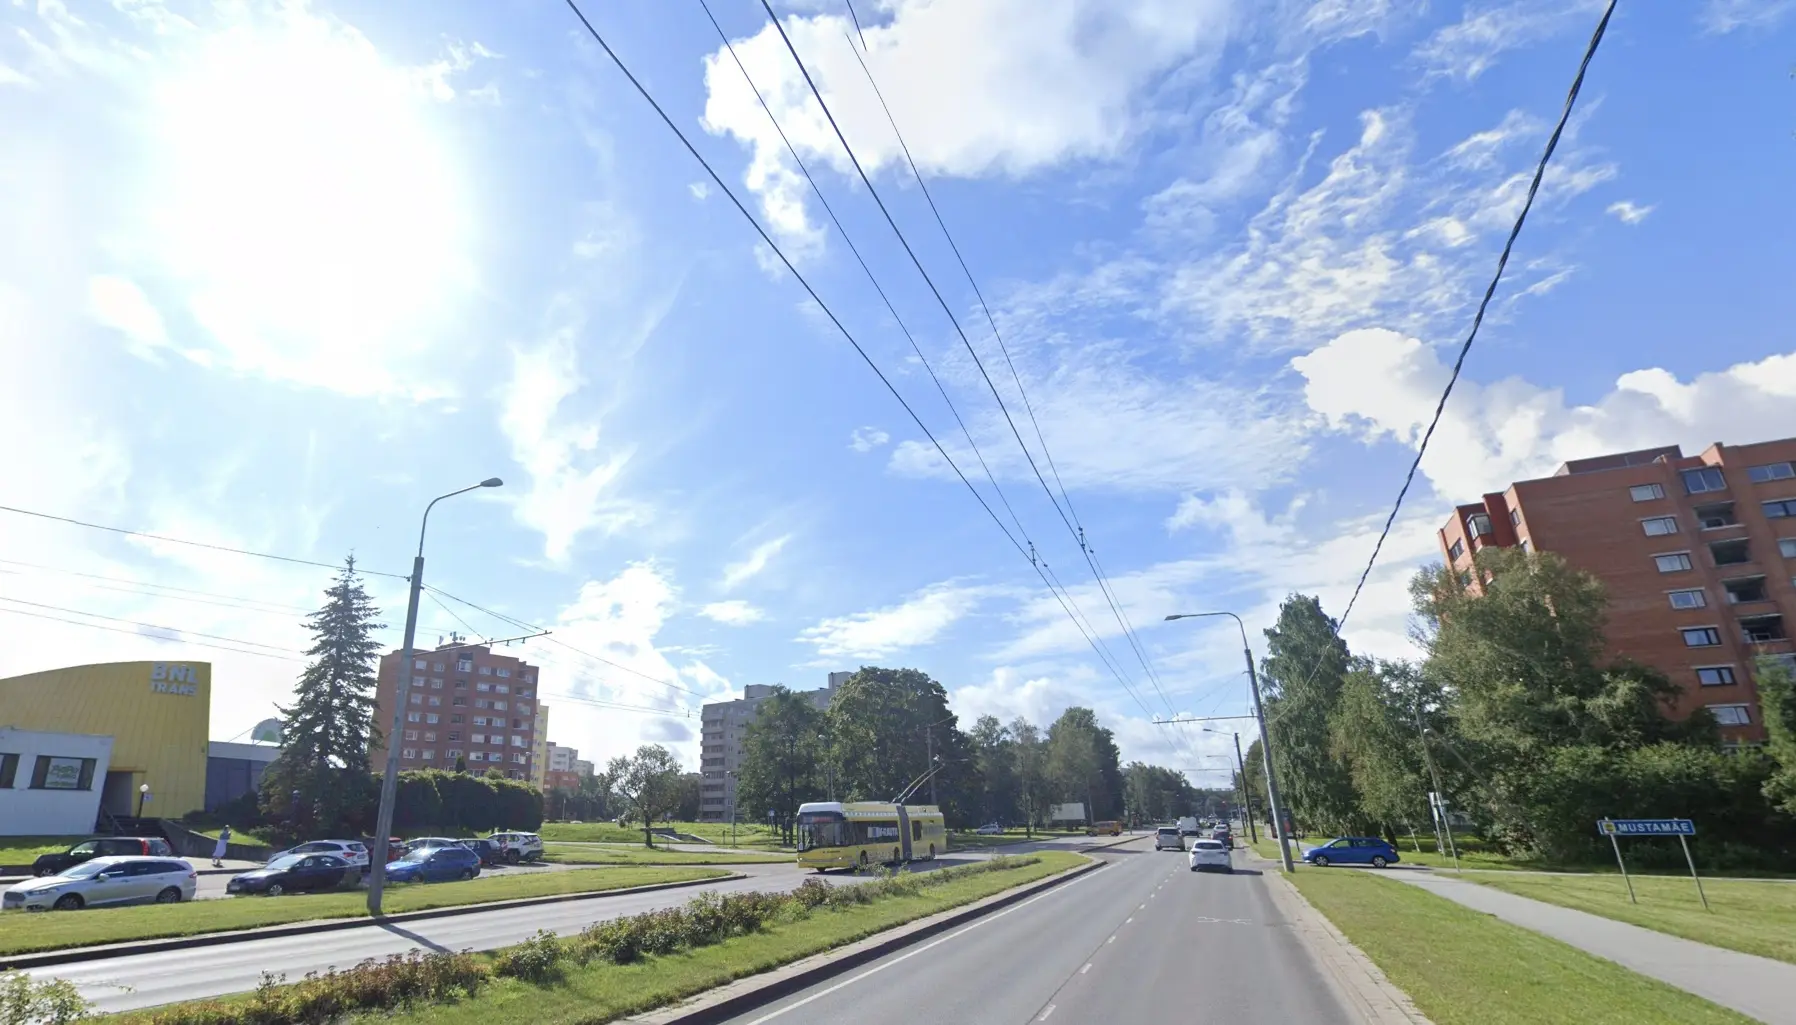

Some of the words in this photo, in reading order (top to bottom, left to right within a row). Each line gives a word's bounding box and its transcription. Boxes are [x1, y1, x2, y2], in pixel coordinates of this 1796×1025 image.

[152, 663, 198, 682] BNL
[151, 681, 197, 696] TRANS
[1618, 822, 1690, 832] MUSTAMÄE
